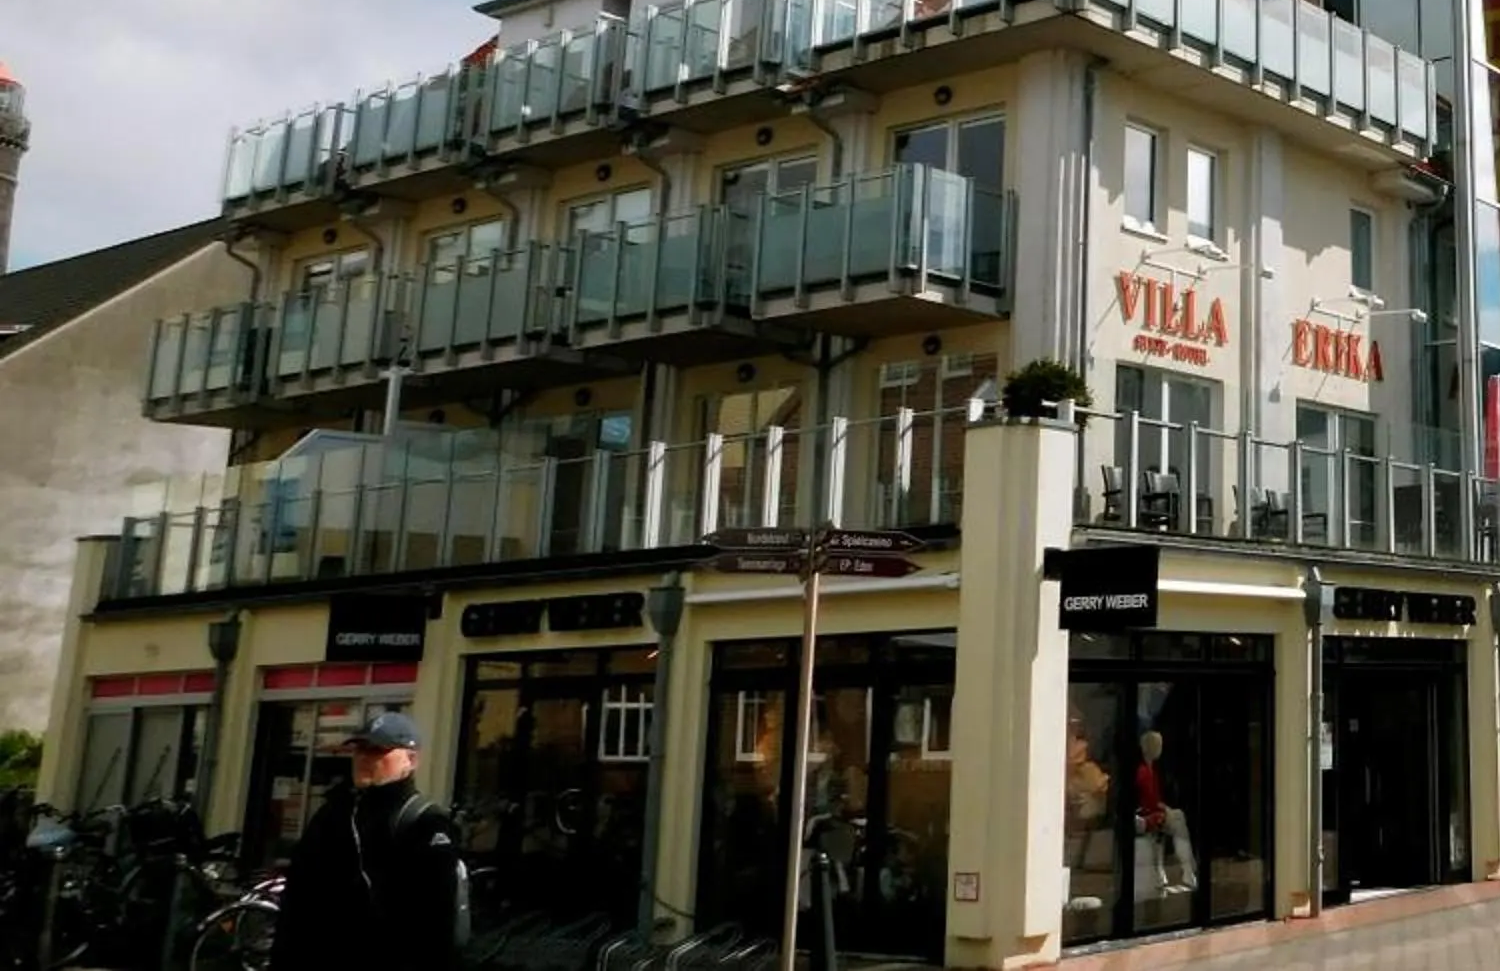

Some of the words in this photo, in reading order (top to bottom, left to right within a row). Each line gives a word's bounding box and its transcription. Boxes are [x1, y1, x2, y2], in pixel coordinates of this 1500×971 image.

[1119, 270, 1228, 348] VILLA
[1290, 318, 1385, 383] ERIKA
[1064, 595, 1104, 611] GERRY
[1105, 593, 1149, 610] WEBER
